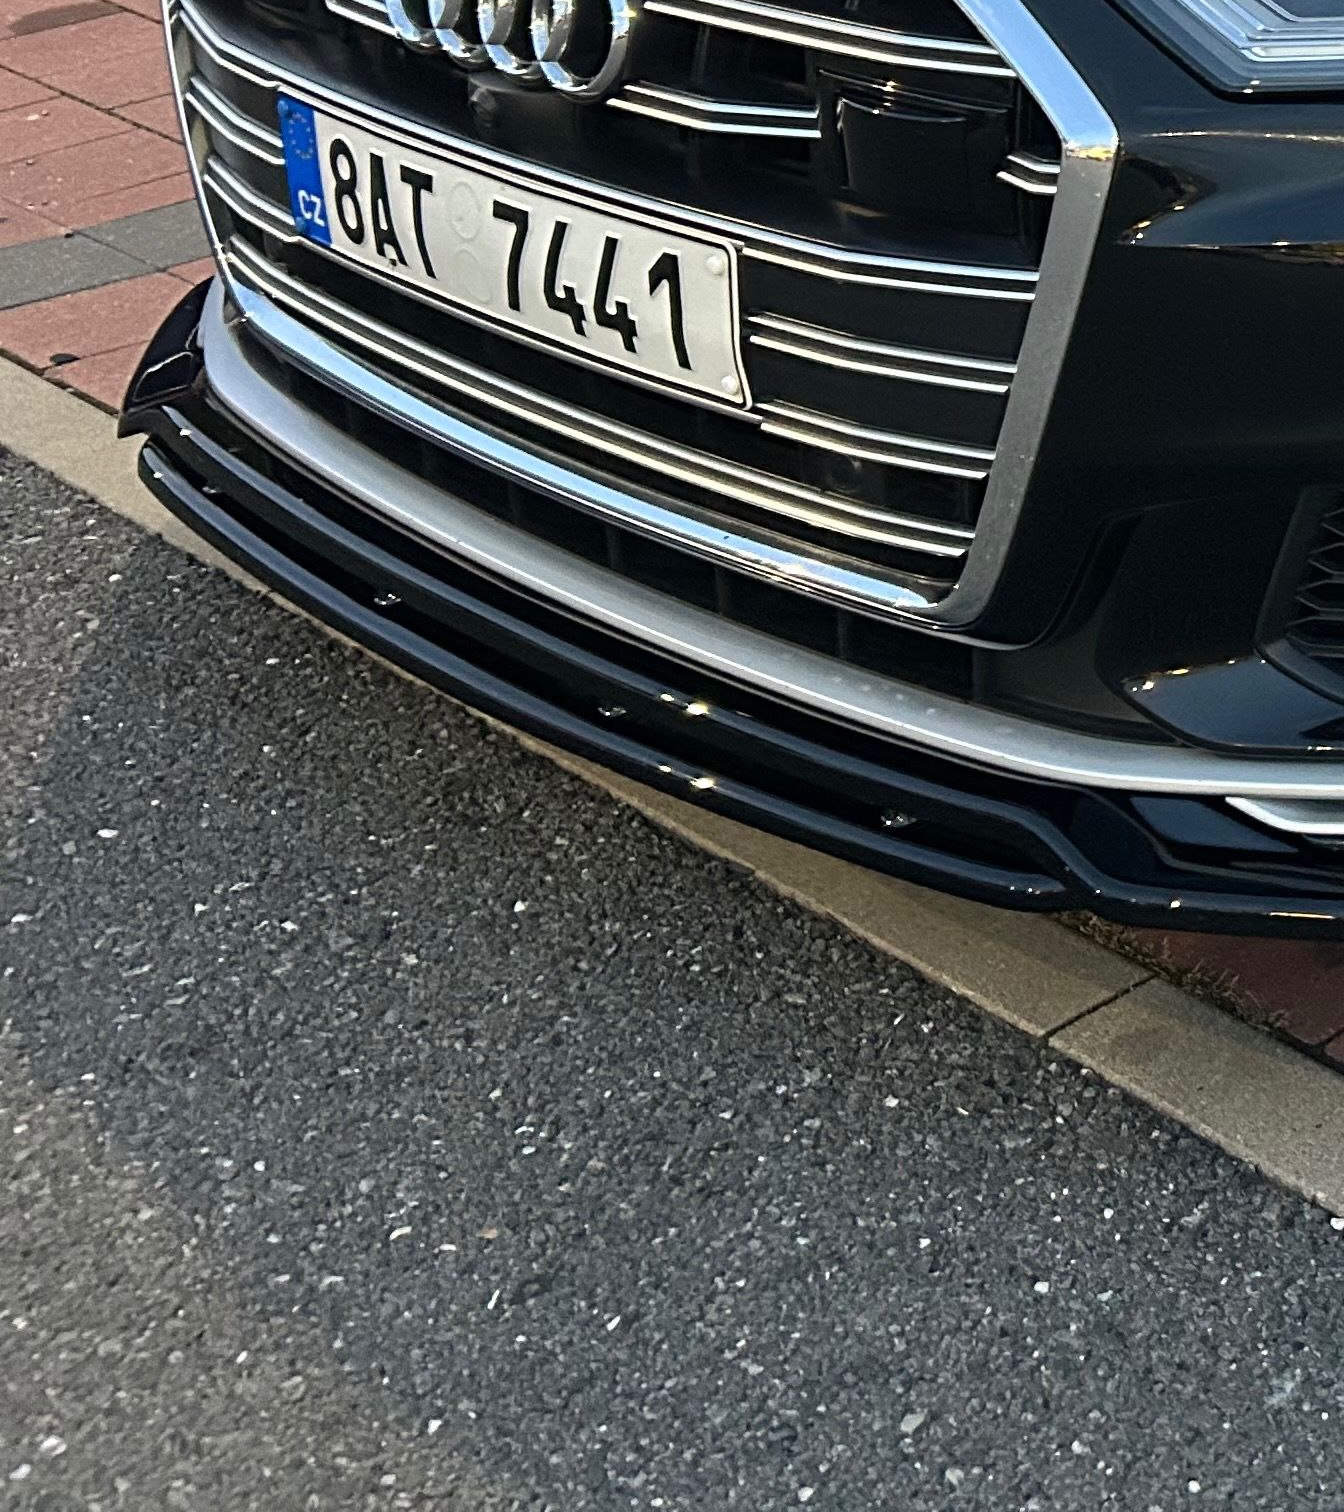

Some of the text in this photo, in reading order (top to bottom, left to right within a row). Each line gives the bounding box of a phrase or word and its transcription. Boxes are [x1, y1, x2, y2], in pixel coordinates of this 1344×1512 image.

[298, 190, 325, 226] CZ
[330, 139, 692, 370] 8AT 7441
